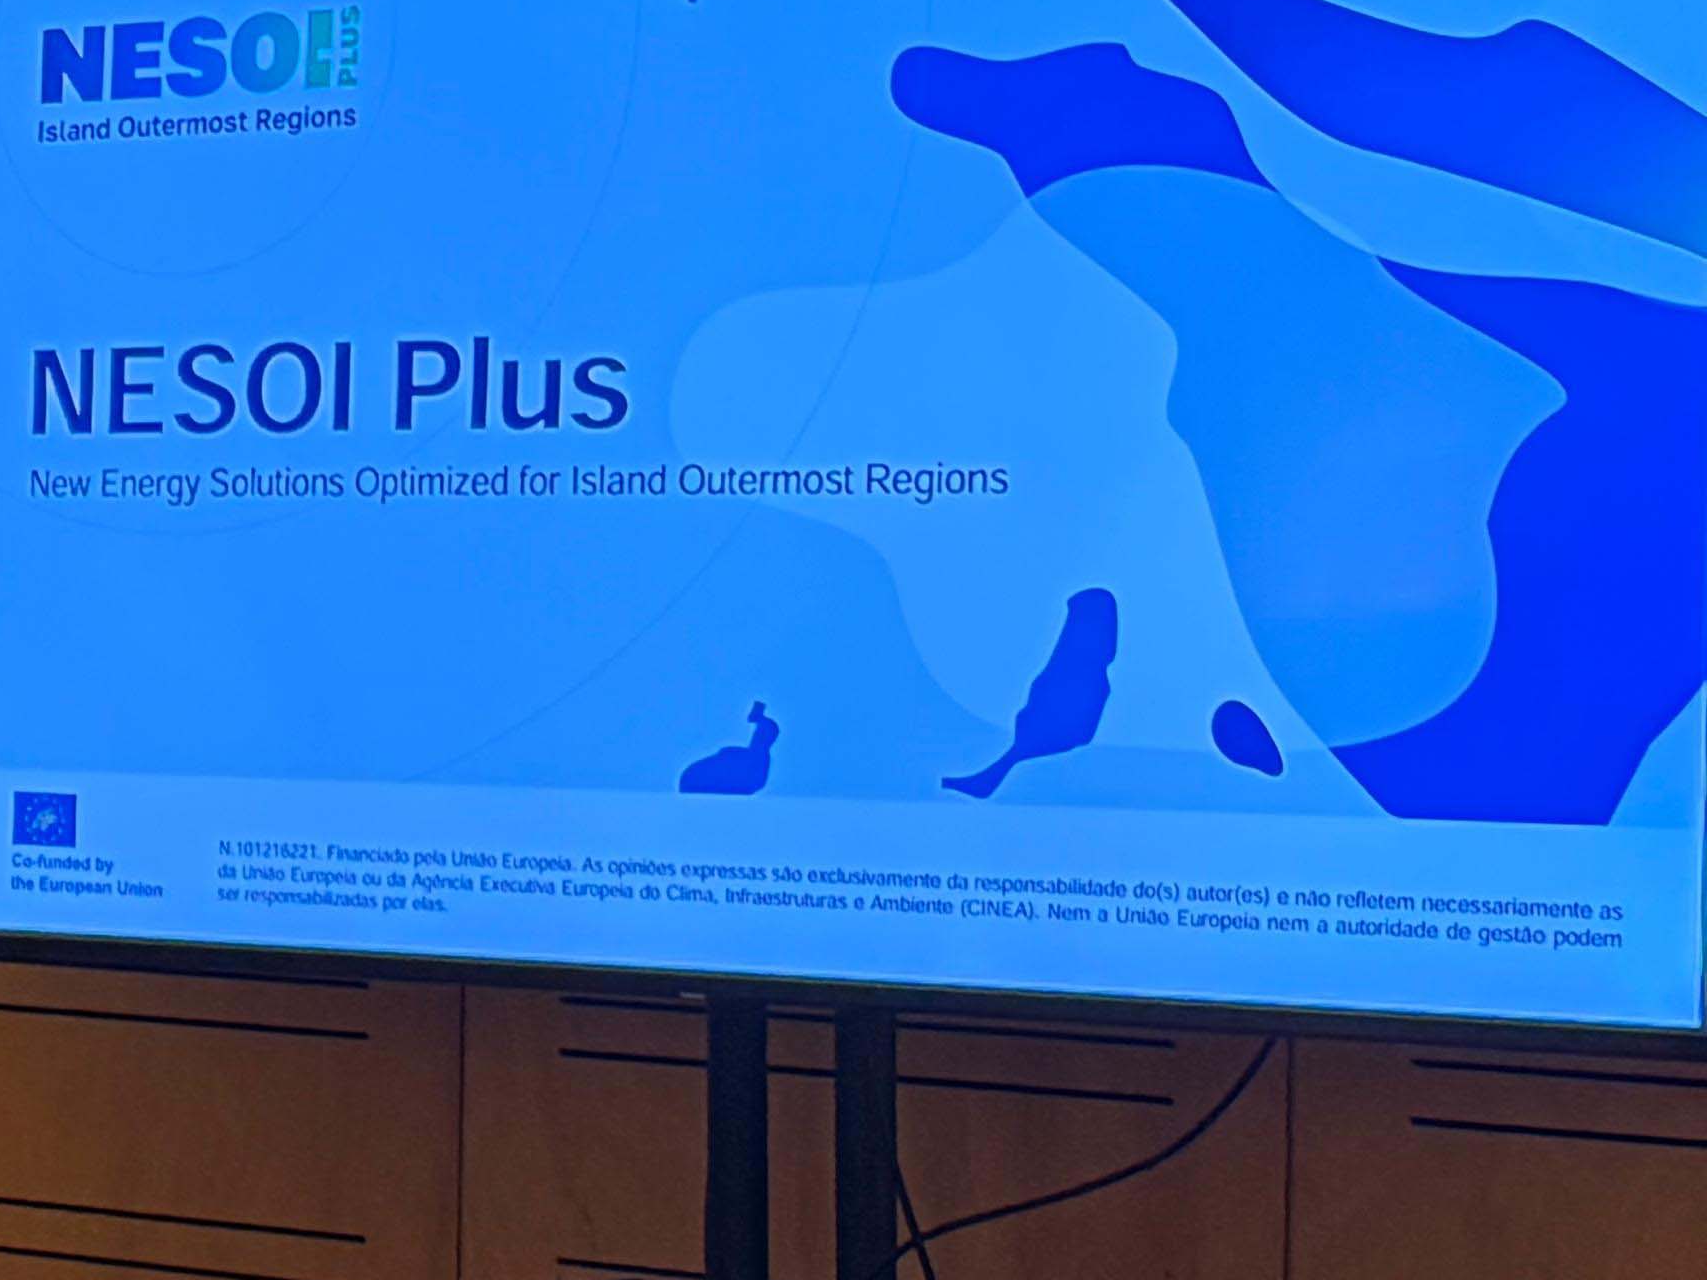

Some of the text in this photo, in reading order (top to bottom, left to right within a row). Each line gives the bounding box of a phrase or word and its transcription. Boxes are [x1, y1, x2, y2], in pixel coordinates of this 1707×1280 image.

[41, 8, 333, 104] NESOI
[337, 4, 360, 88] PLUS
[37, 104, 357, 143] Island Outermost Regions
[31, 336, 629, 435] NESOI Plus
[31, 462, 1009, 506] New Energy Solutions Optimized for Island Outermost Regions
[11, 875, 163, 898] the European Union
[12, 853, 113, 876] Co-funded by
[327, 844, 410, 865] Financiado
[414, 848, 446, 868] pela
[452, 850, 497, 869] União
[582, 856, 603, 872] As
[608, 858, 677, 880] opiniões
[681, 862, 767, 884] expressas
[772, 865, 803, 883] são
[807, 866, 941, 890] exclusivamente
[947, 873, 968, 890] da
[974, 875, 1127, 898] responsabilidade
[1133, 881, 1180, 903] do(s)
[1186, 884, 1270, 907] autor(es)
[1277, 892, 1289, 904] e
[1296, 889, 1331, 908] não
[1336, 890, 1415, 912] refletem
[1421, 895, 1593, 920] necessariamente
[1599, 904, 1624, 921] as
[217, 888, 448, 913] ser responsabilizadas por elas.
[217, 864, 237, 880] da
[242, 864, 285, 882] União
[291, 866, 357, 887] Europeia
[362, 871, 382, 886] ou
[387, 869, 406, 888] da
[412, 872, 474, 895] Agência
[480, 875, 555, 896] Executiva
[562, 878, 633, 900] Europeia
[639, 883, 661, 901] do
[666, 883, 719, 905] Clima,
[725, 888, 848, 911] Infraestruturas
[853, 897, 864, 910] e
[870, 894, 954, 915] Ambiente
[1048, 903, 1091, 922] Nem
[1097, 909, 1109, 922] a
[1116, 906, 1170, 926] União
[1177, 909, 1260, 933] Europeia
[1267, 918, 1310, 933] nem
[1317, 920, 1328, 934] a
[1336, 917, 1438, 939] autoridade
[1446, 922, 1472, 941] de
[1478, 925, 1545, 947] gestão
[1553, 927, 1623, 950] podem
